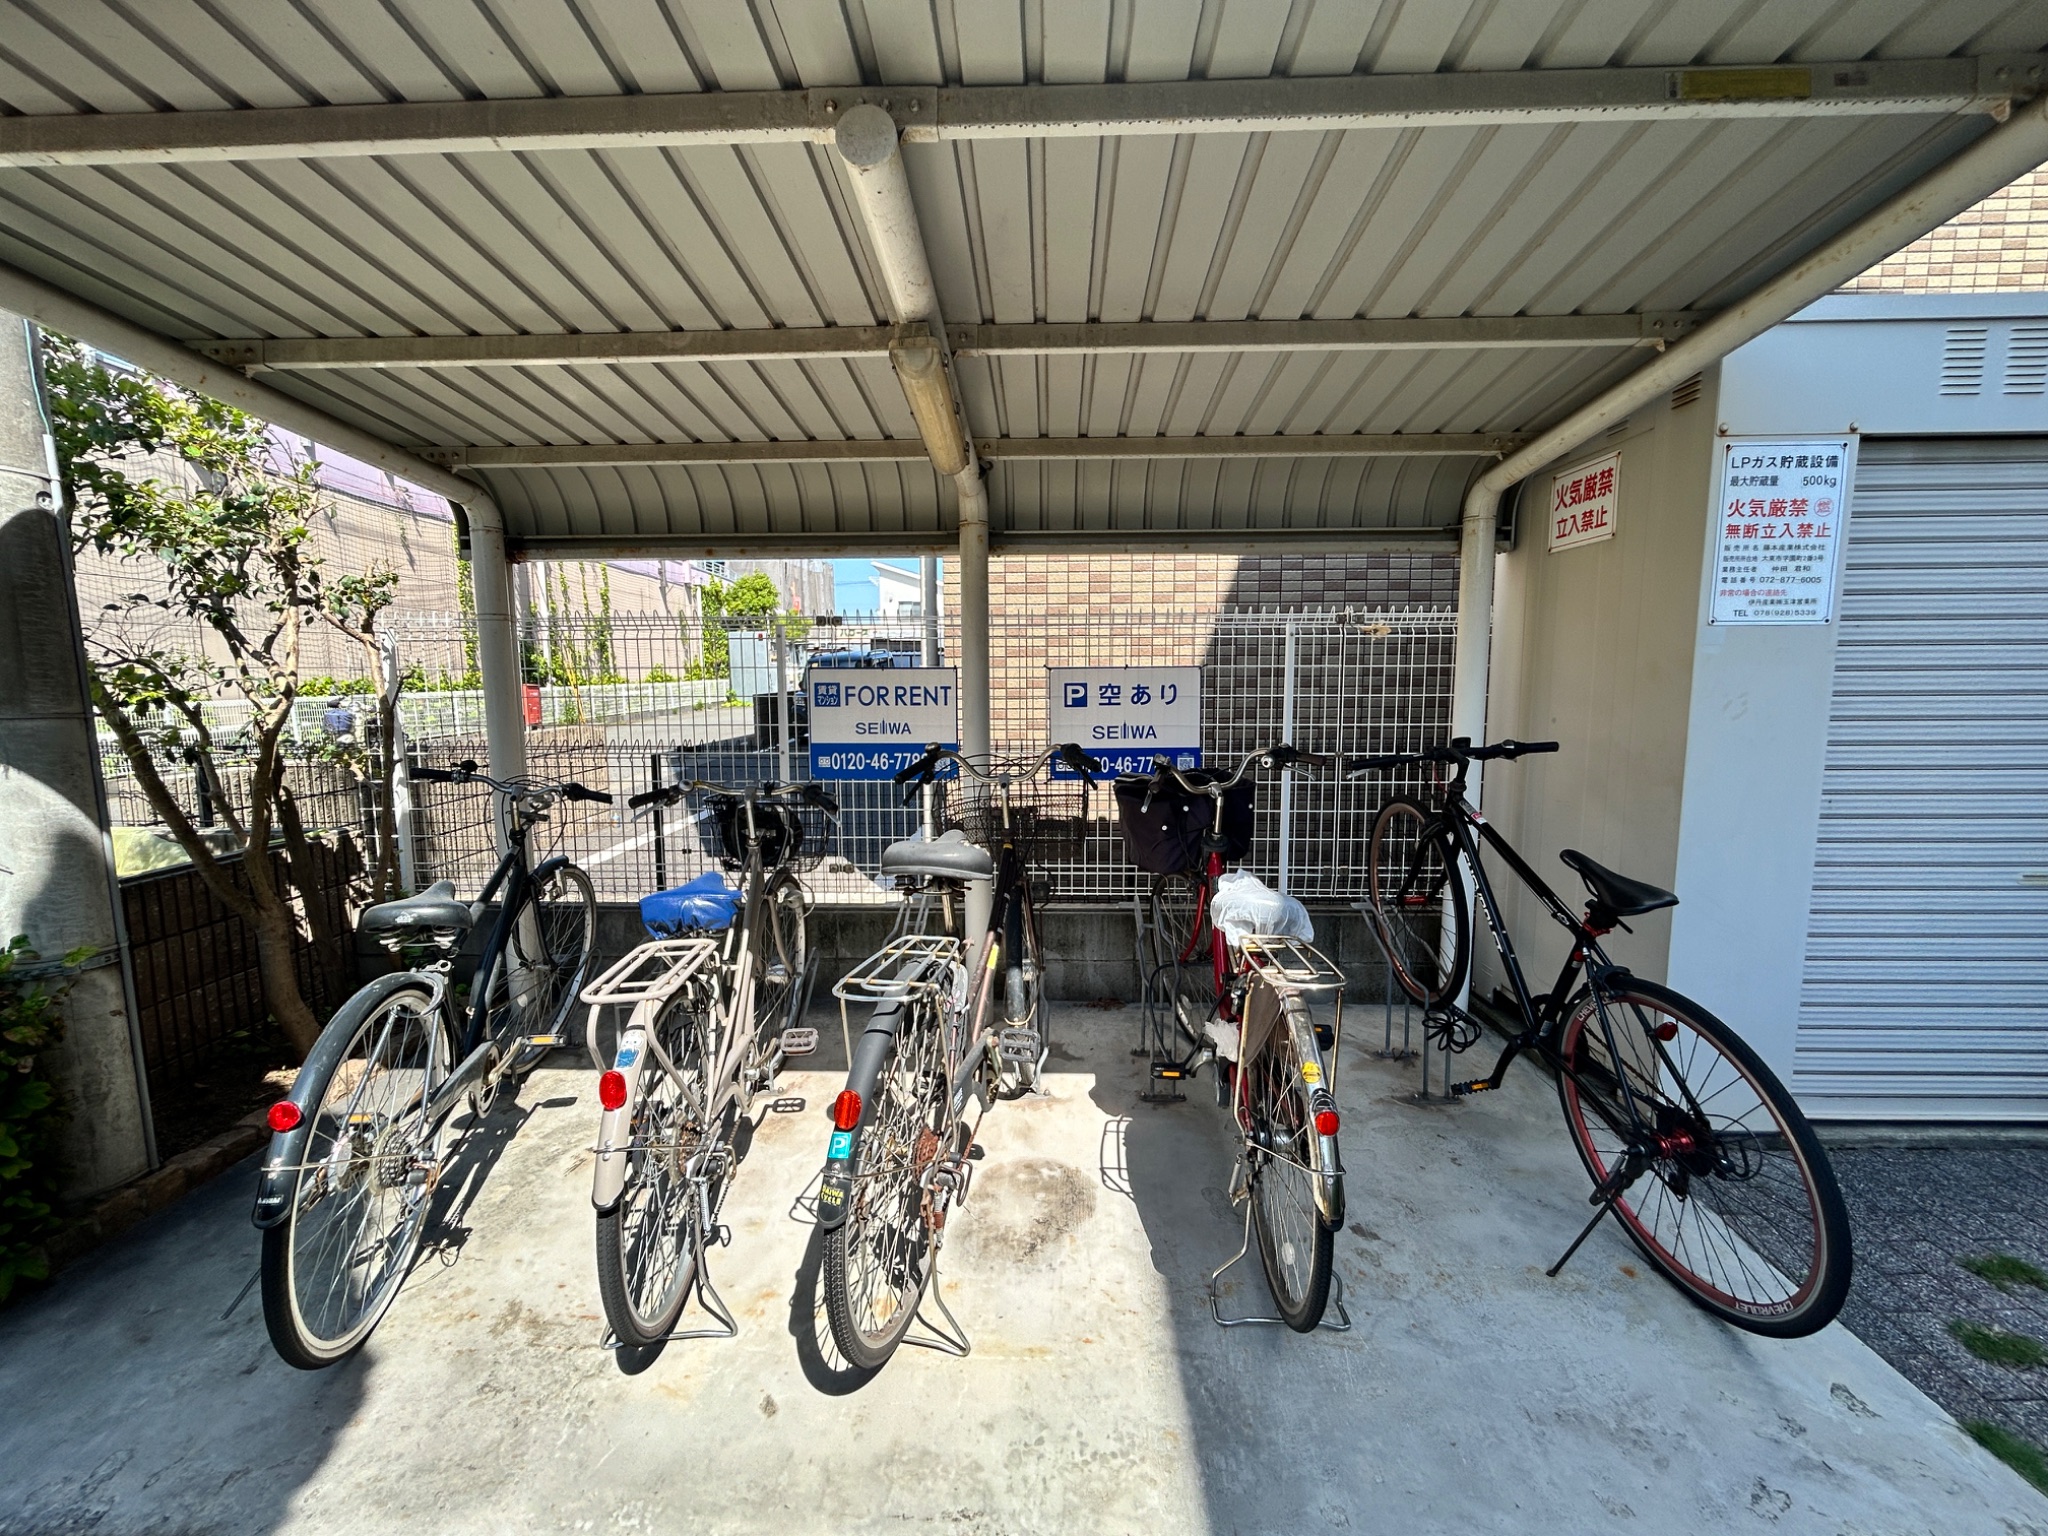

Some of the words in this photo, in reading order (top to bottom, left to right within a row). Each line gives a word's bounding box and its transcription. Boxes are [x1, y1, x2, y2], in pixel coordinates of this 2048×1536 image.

[1731, 455, 1839, 469] LPガス貯蔵設備
[1554, 466, 1614, 512] 火気厳禁
[1729, 476, 1779, 487] 最大貯蔵量
[1802, 475, 1837, 487] 500kg
[1727, 498, 1809, 518] 火気厳禁
[1555, 504, 1608, 540] 立入禁止
[1725, 522, 1832, 539] 無断立入禁止
[1721, 576, 1756, 584] 電話番号
[1759, 576, 1822, 584] 072-877-6005
[1733, 609, 1749, 617] TEL
[817, 695, 838, 706] マンション
[845, 685, 890, 707] FOR
[895, 685, 952, 707] RENT
[1066, 685, 1086, 706] P
[1098, 683, 1178, 706] 空あり
[831, 752, 928, 770] 0120-46-778
[831, 1137, 846, 1155] P
[1734, 1300, 1794, 1316] CHEVROLET
